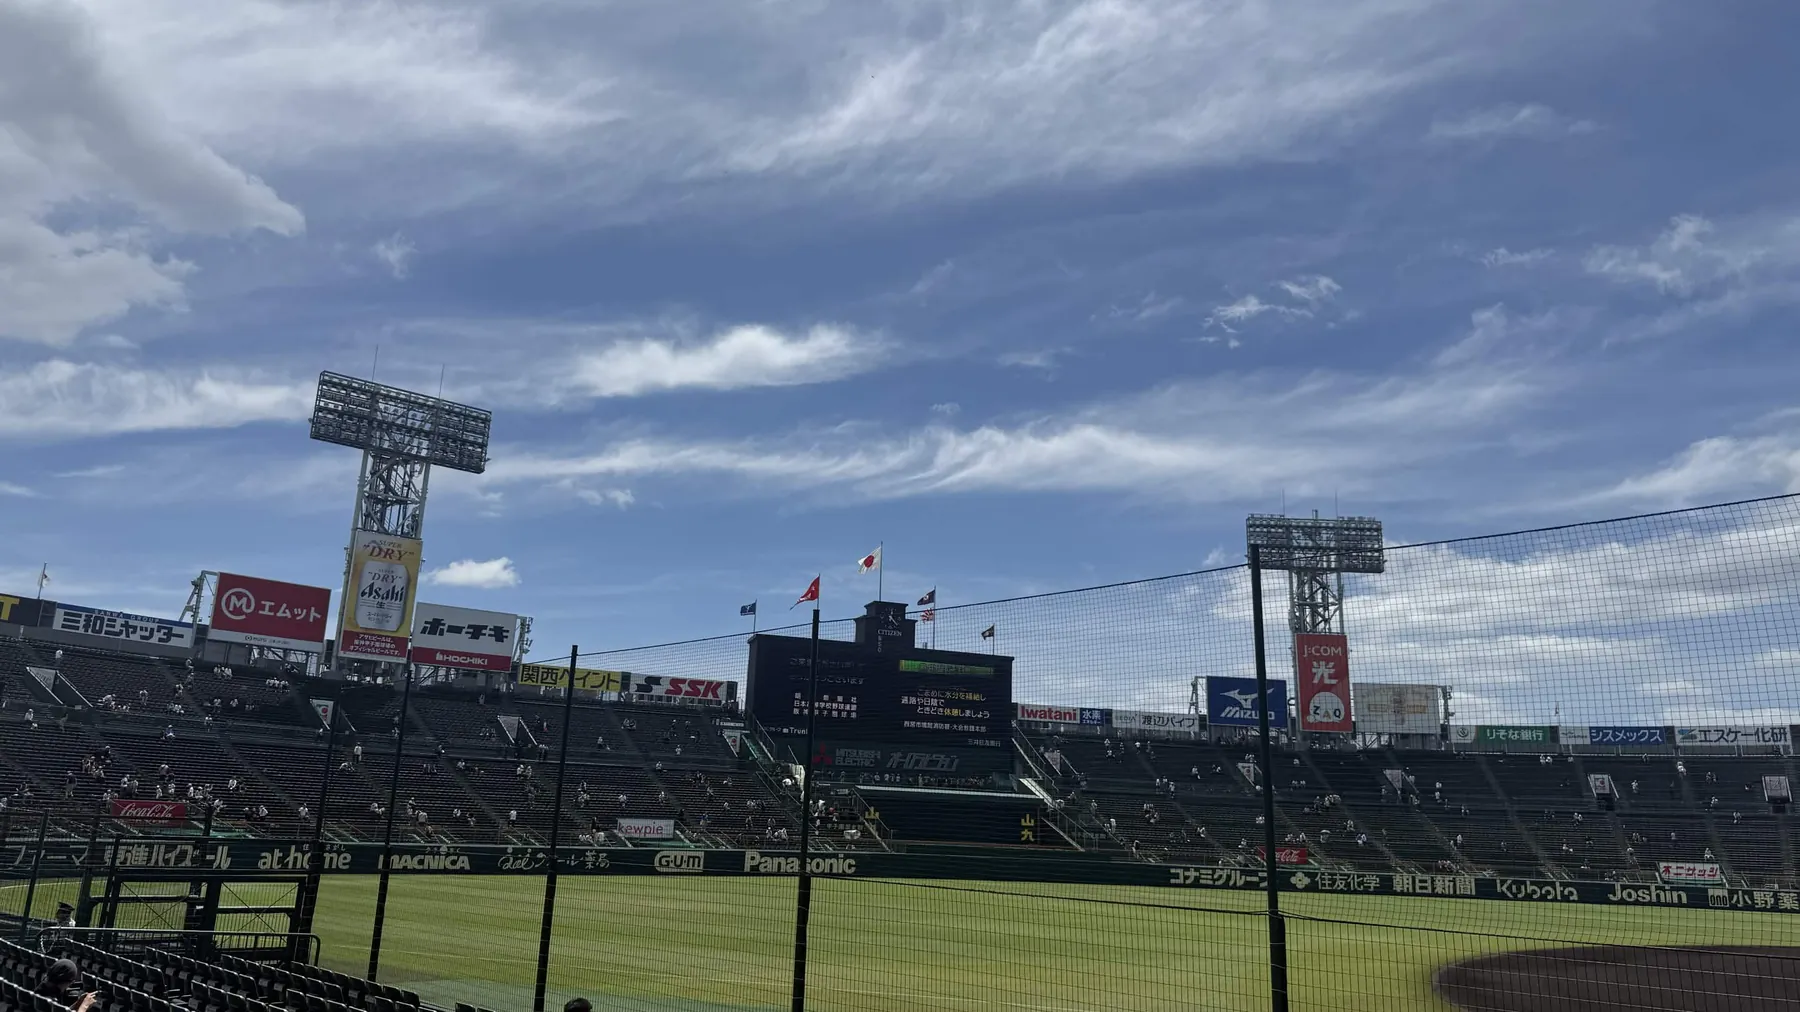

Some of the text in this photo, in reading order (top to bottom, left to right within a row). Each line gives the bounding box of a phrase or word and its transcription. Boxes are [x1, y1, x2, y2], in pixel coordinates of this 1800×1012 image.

[361, 582, 405, 603] Asahi
[258, 600, 322, 623] エムット
[376, 601, 387, 610] 生
[60, 610, 185, 642] 三和シャッター
[420, 617, 510, 643] ホーチキ
[878, 629, 902, 637] CITIZEN
[443, 654, 488, 666] HOCHIKI
[1303, 644, 1342, 657] J:COM
[1312, 660, 1339, 685] 光
[665, 678, 725, 699] SSK
[917, 706, 991, 719] ときどき休憩しましょう
[1020, 706, 1077, 721] Iwatani
[1220, 706, 1275, 720] MIZUO
[1486, 728, 1544, 741] りそな銀行
[1591, 728, 1662, 743] シスメックス
[1698, 727, 1788, 744] エスケー化研
[617, 823, 664, 838] kewpie
[104, 844, 232, 870] 東進ハイスール
[534, 851, 609, 870] クール薬局
[1662, 865, 1718, 877] 不二サッシ
[1316, 872, 1380, 891] 住友化学
[1392, 874, 1475, 895] 朝日新聞
[1497, 879, 1578, 900] Kubota
[1608, 882, 1688, 904] Joshin
[1731, 890, 1800, 911] 小野薬
